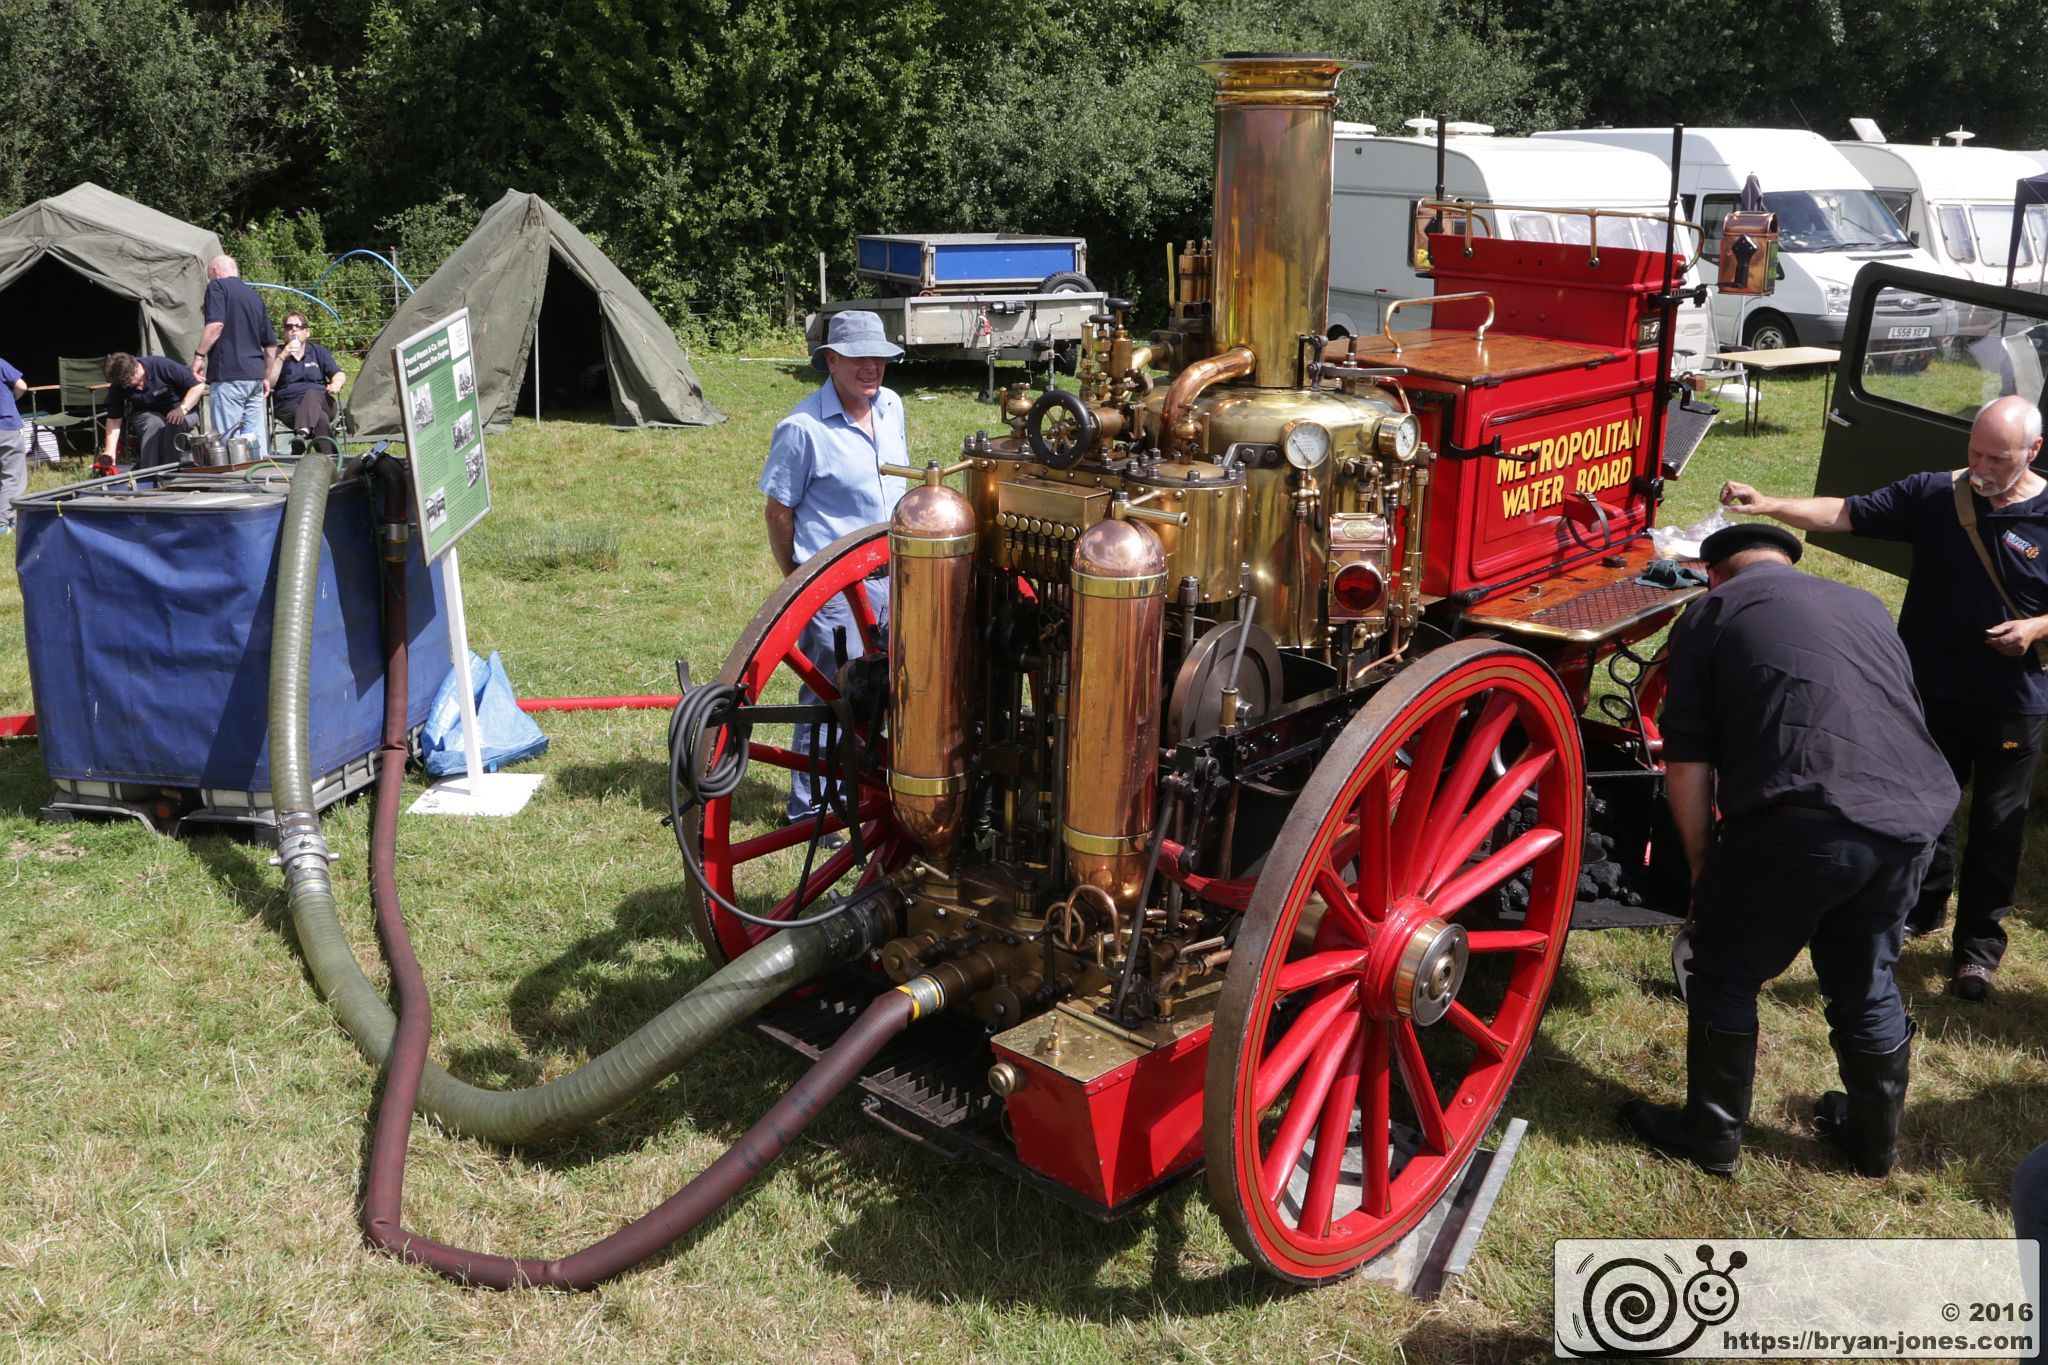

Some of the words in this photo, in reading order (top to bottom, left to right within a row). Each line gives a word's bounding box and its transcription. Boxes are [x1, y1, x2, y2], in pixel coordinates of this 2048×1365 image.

[1891, 328, 1912, 338] LS58
[1912, 327, 1928, 337] XEP
[1497, 416, 1643, 485] METROPOLITAN
[1502, 475, 1565, 518] WATER
[1576, 456, 1632, 494] BOARD
